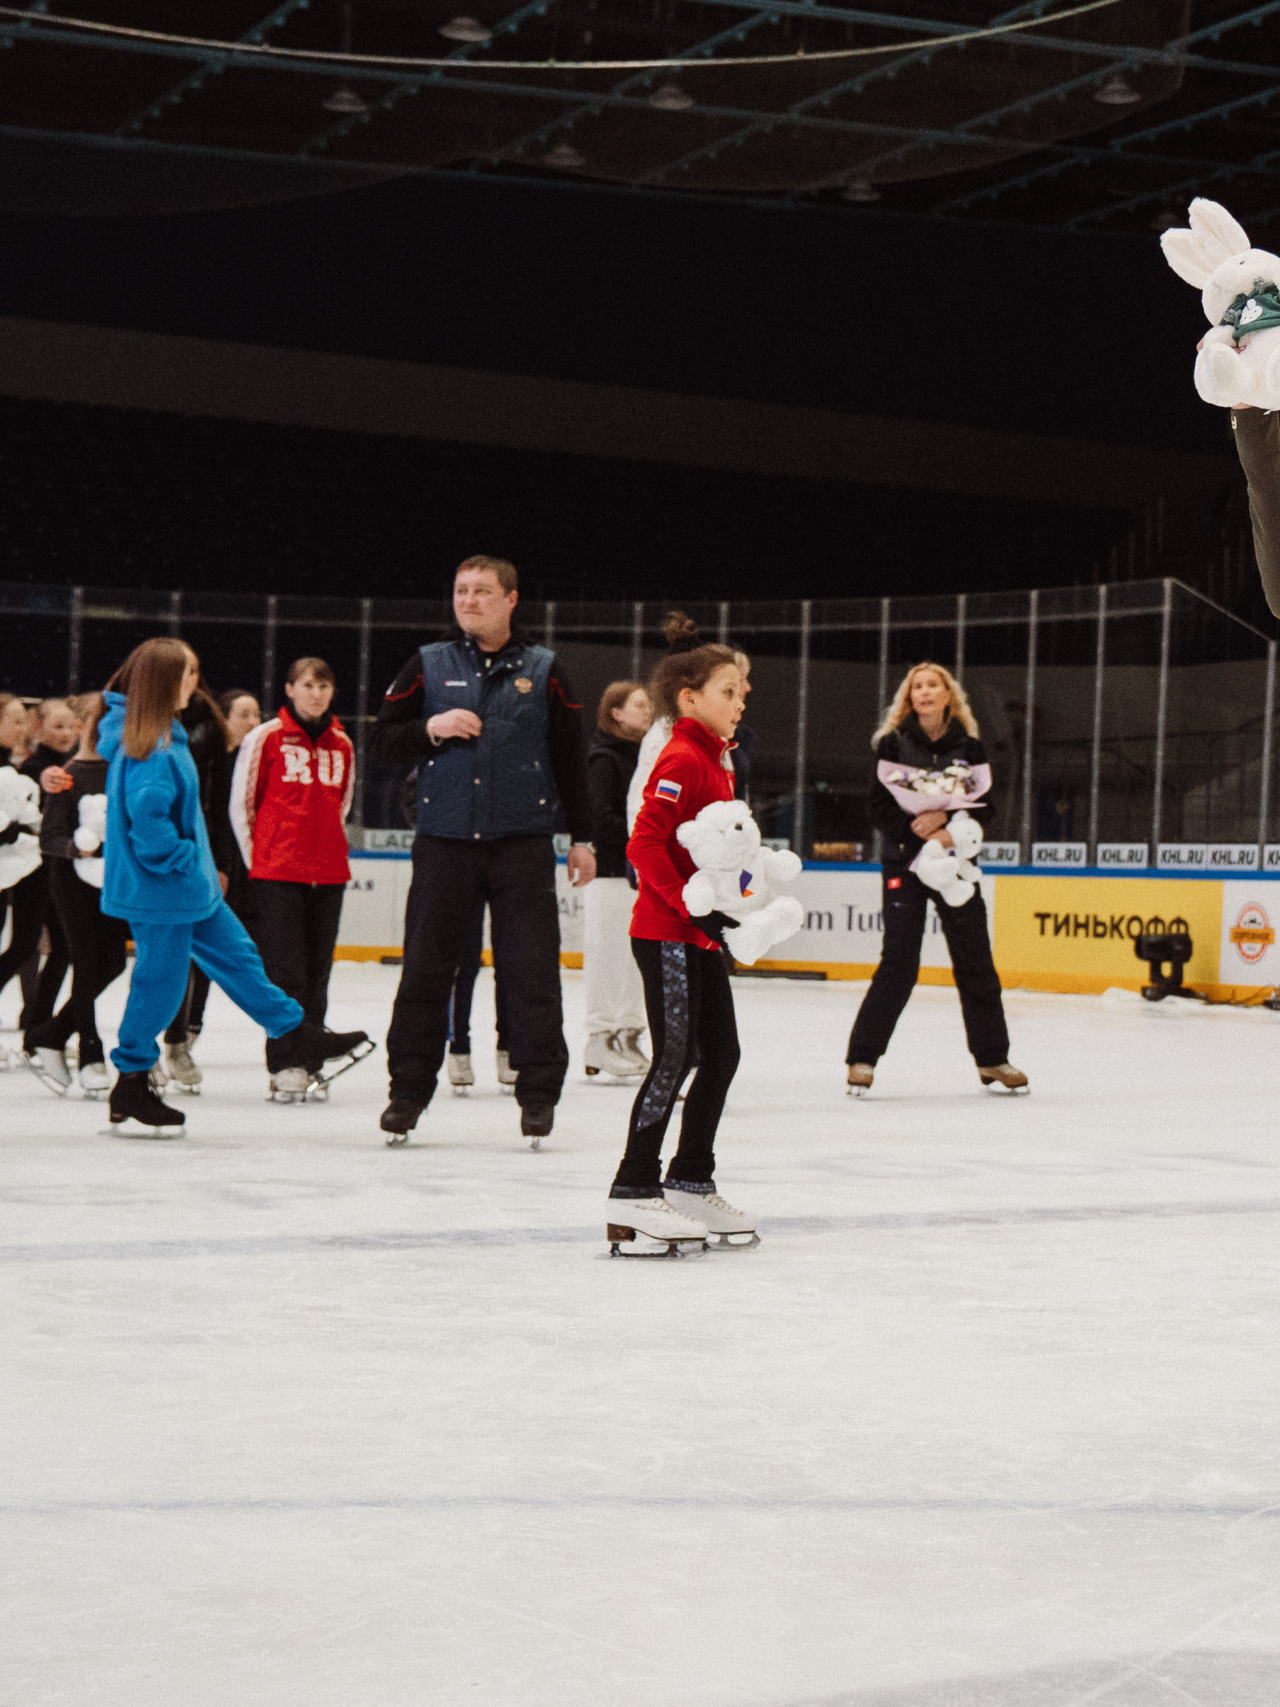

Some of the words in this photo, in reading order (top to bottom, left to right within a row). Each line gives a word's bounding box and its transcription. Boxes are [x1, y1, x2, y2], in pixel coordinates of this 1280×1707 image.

[280, 744, 345, 787] RU
[1035, 848, 1082, 862] KHL.RU
[1100, 849, 1144, 863] KHL.RU
[1161, 850, 1203, 864] KHL.RU
[1210, 850, 1254, 865] KHL.RU
[1034, 912, 1189, 940] ТИНЬКОФФ
